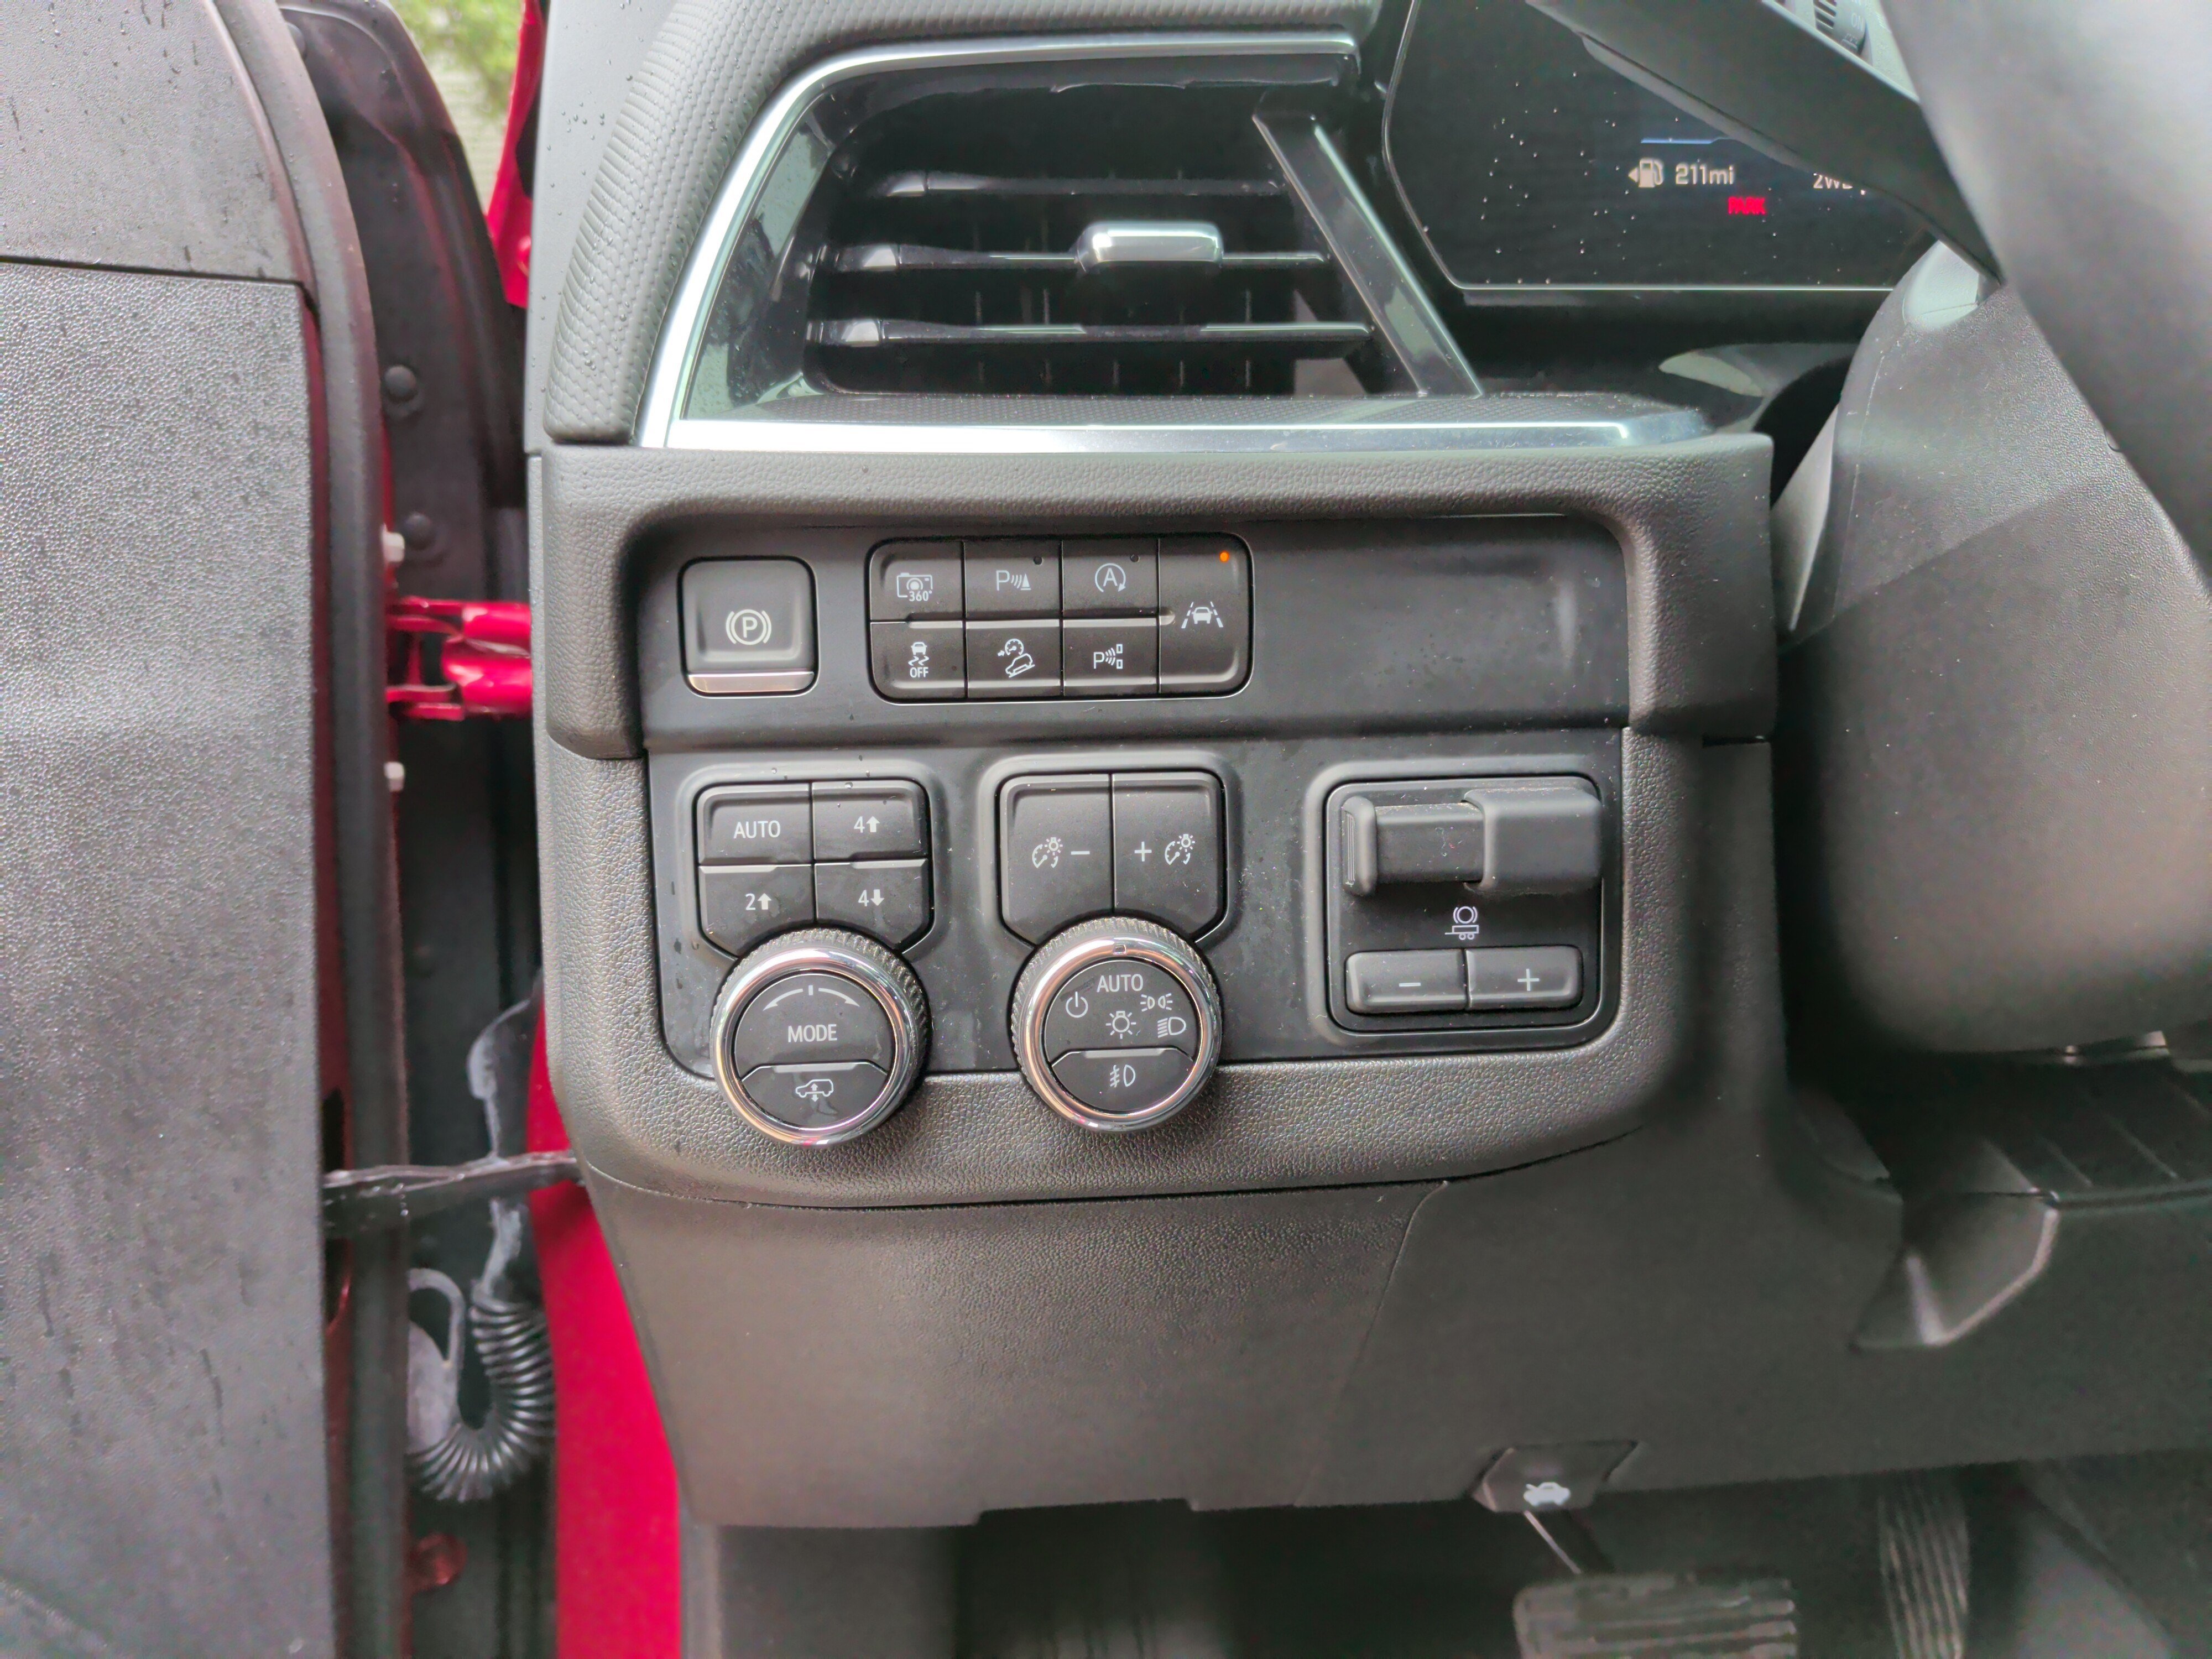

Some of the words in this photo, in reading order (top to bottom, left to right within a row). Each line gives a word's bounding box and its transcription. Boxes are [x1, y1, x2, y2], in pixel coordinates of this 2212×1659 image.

[1676, 163, 1734, 185] 211mi
[1728, 197, 1766, 215] PARK
[910, 667, 928, 678] OFF
[733, 820, 781, 839] AUTO
[853, 816, 865, 833] 4
[745, 893, 756, 911] 2
[858, 889, 869, 907] 4
[1097, 974, 1144, 993] AUTO
[787, 1024, 838, 1043] MODE
